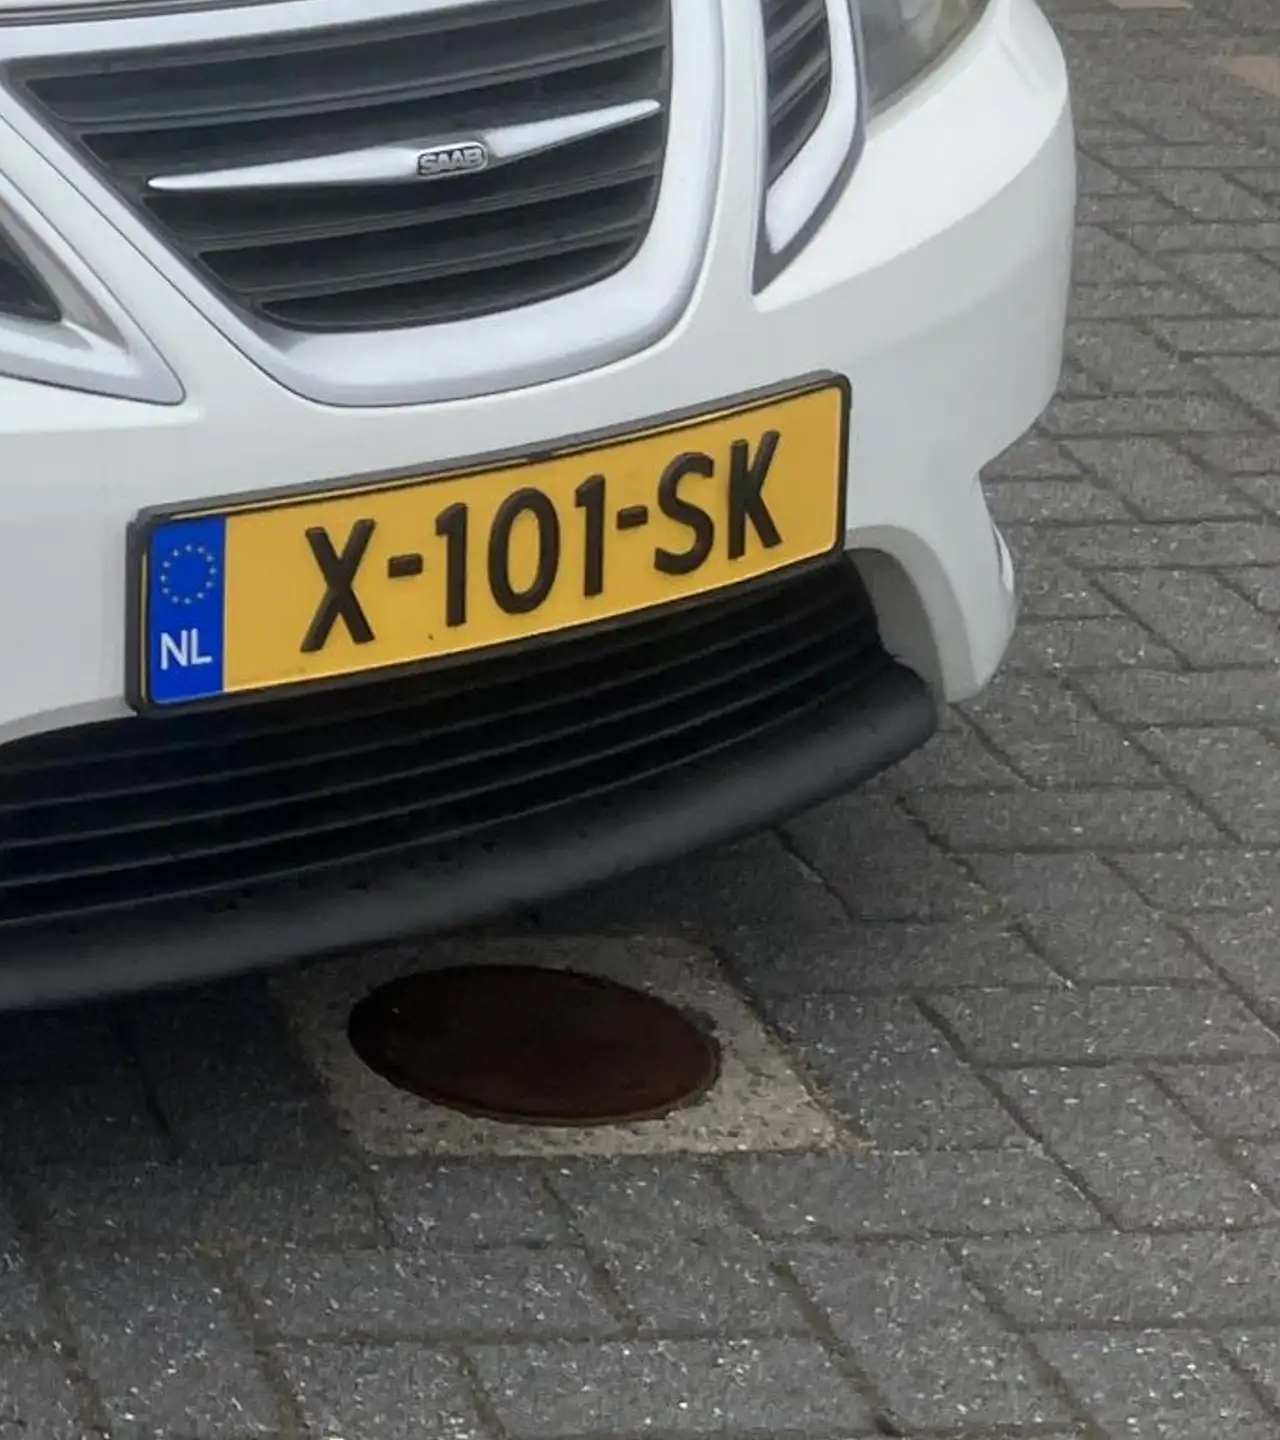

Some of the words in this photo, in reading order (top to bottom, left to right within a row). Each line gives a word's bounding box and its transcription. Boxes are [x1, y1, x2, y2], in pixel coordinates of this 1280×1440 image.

[419, 146, 483, 175] SAAB
[300, 429, 782, 653] X-101-SK
[159, 627, 213, 671] NL
